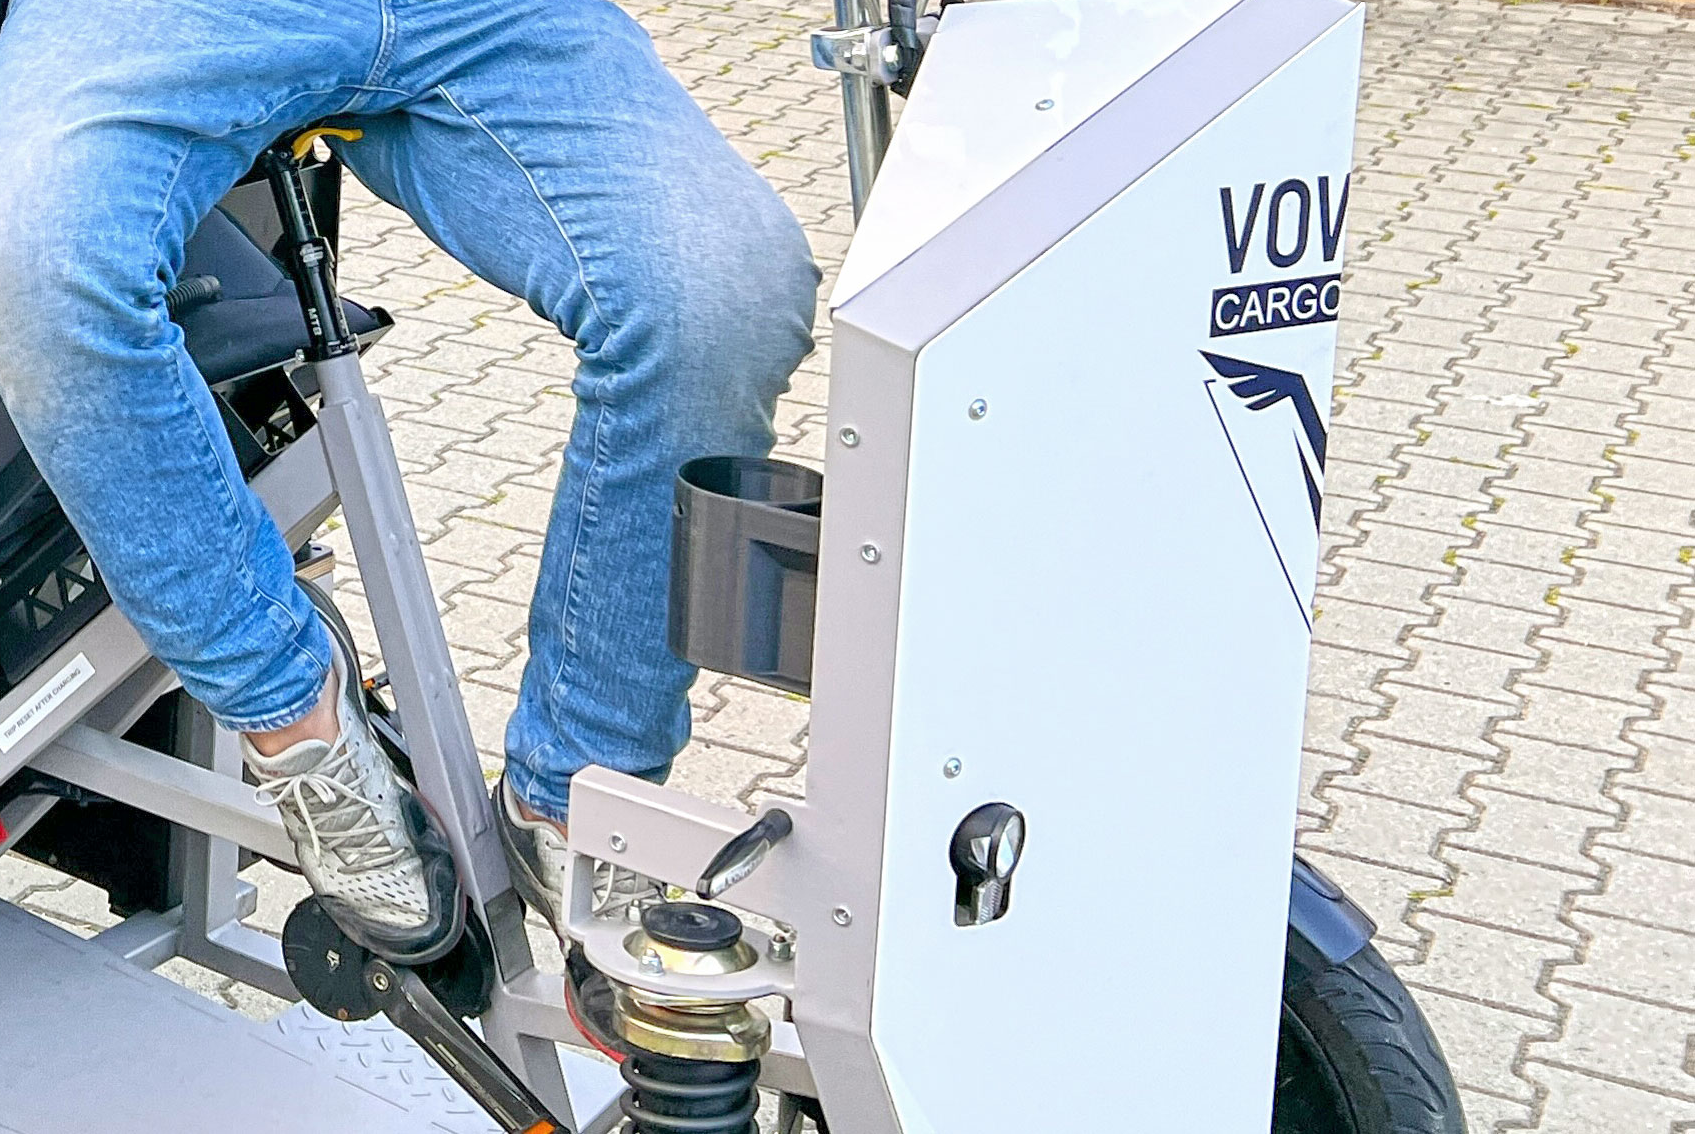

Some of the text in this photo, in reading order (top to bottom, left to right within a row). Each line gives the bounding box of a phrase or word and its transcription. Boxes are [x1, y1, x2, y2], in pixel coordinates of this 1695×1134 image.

[1214, 279, 1341, 330] CARGO
[16, 708, 35, 728] RESET
[34, 692, 54, 712] AFTER
